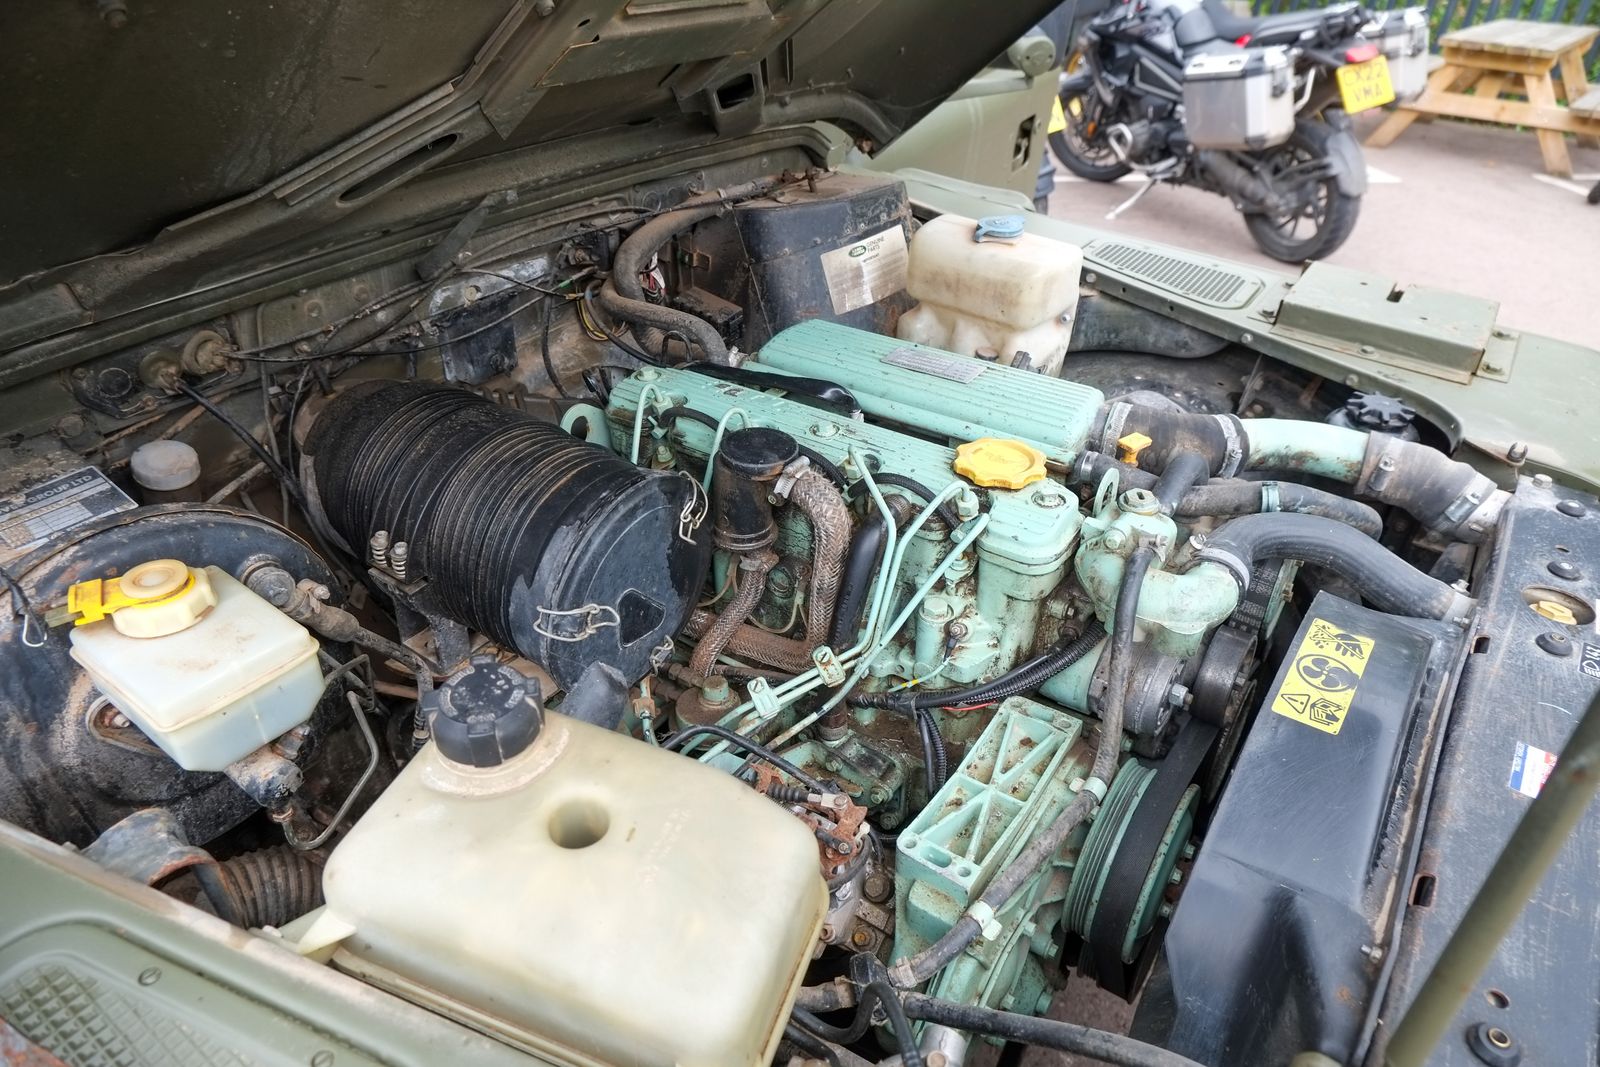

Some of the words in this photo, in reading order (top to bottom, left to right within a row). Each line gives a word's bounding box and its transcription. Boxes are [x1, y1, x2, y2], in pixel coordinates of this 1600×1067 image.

[867, 244, 881, 253] PARTS
[26, 483, 70, 503] GROUP
[71, 475, 93, 487] LTD
